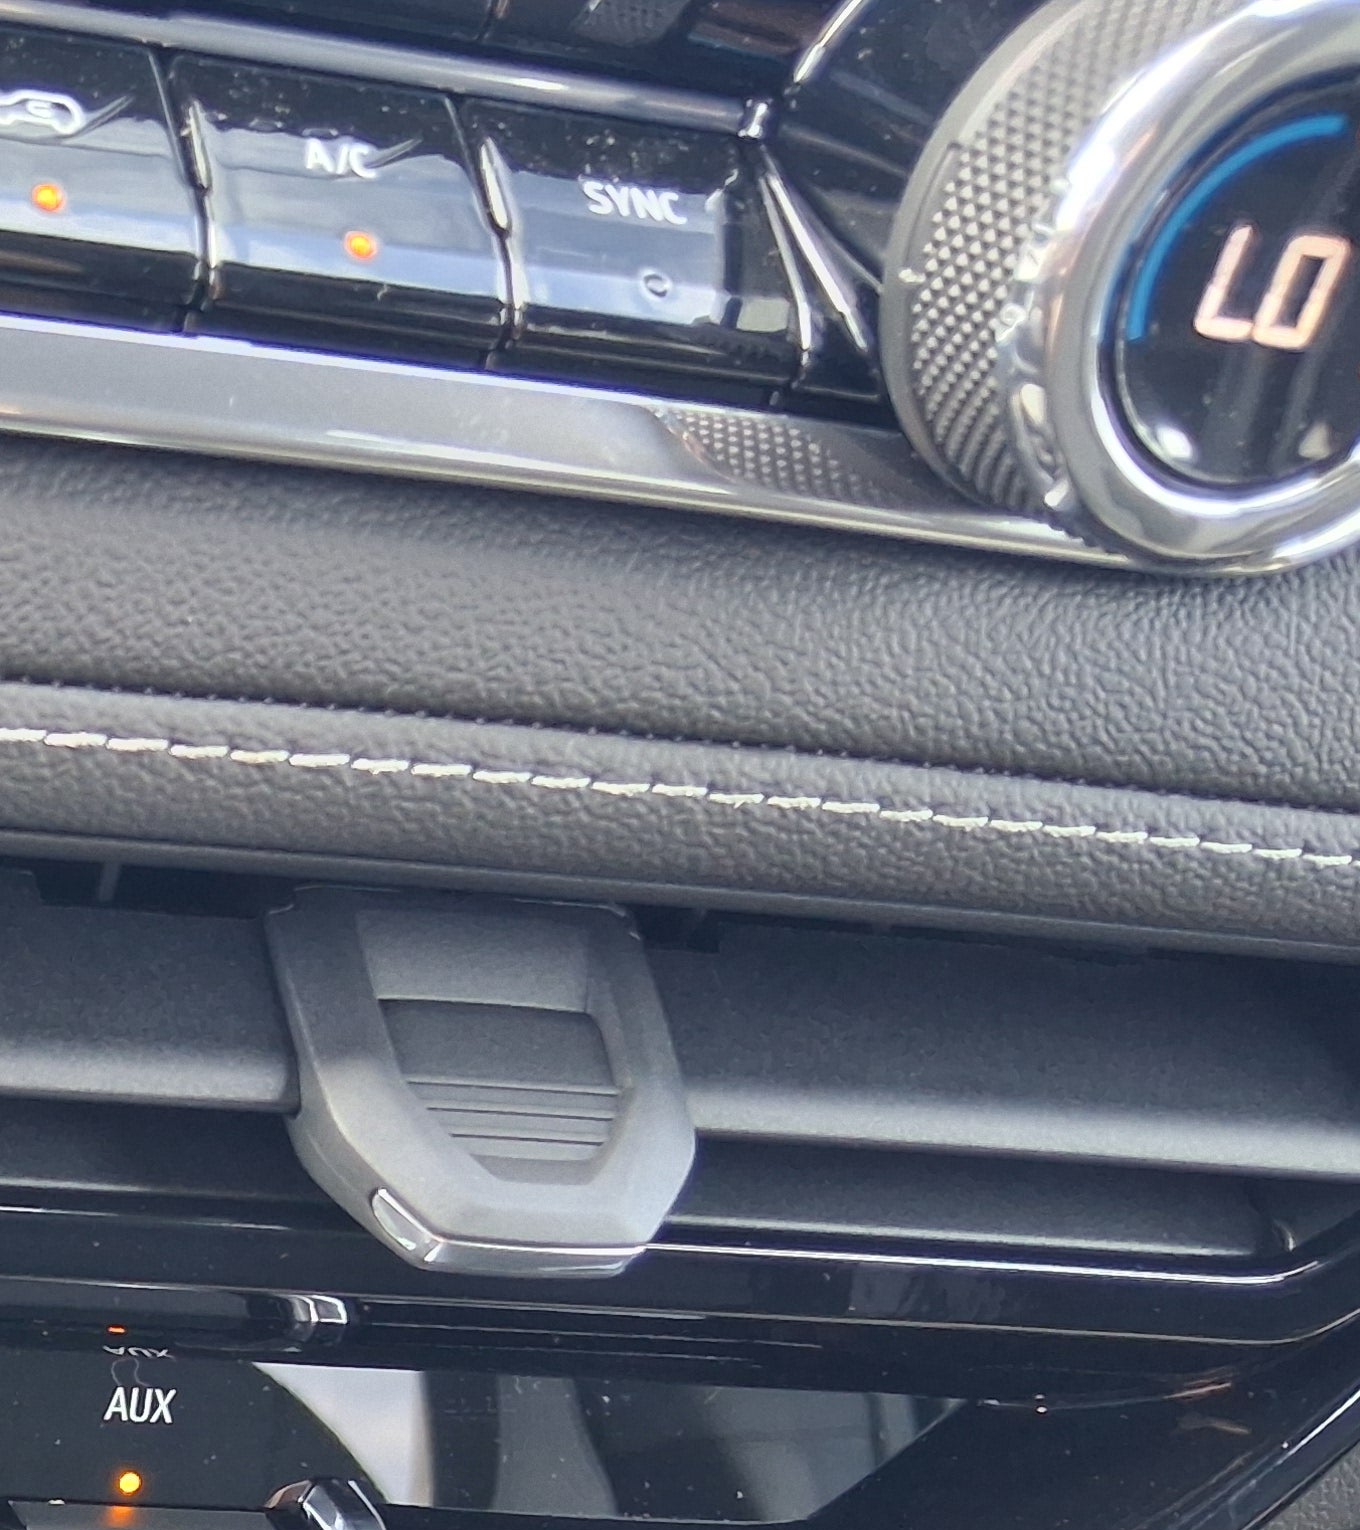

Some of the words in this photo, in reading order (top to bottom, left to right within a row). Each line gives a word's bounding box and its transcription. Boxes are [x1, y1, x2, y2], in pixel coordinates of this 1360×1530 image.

[304, 137, 377, 179] A/C
[582, 180, 688, 225] SYNC
[103, 1386, 177, 1424] AUX
